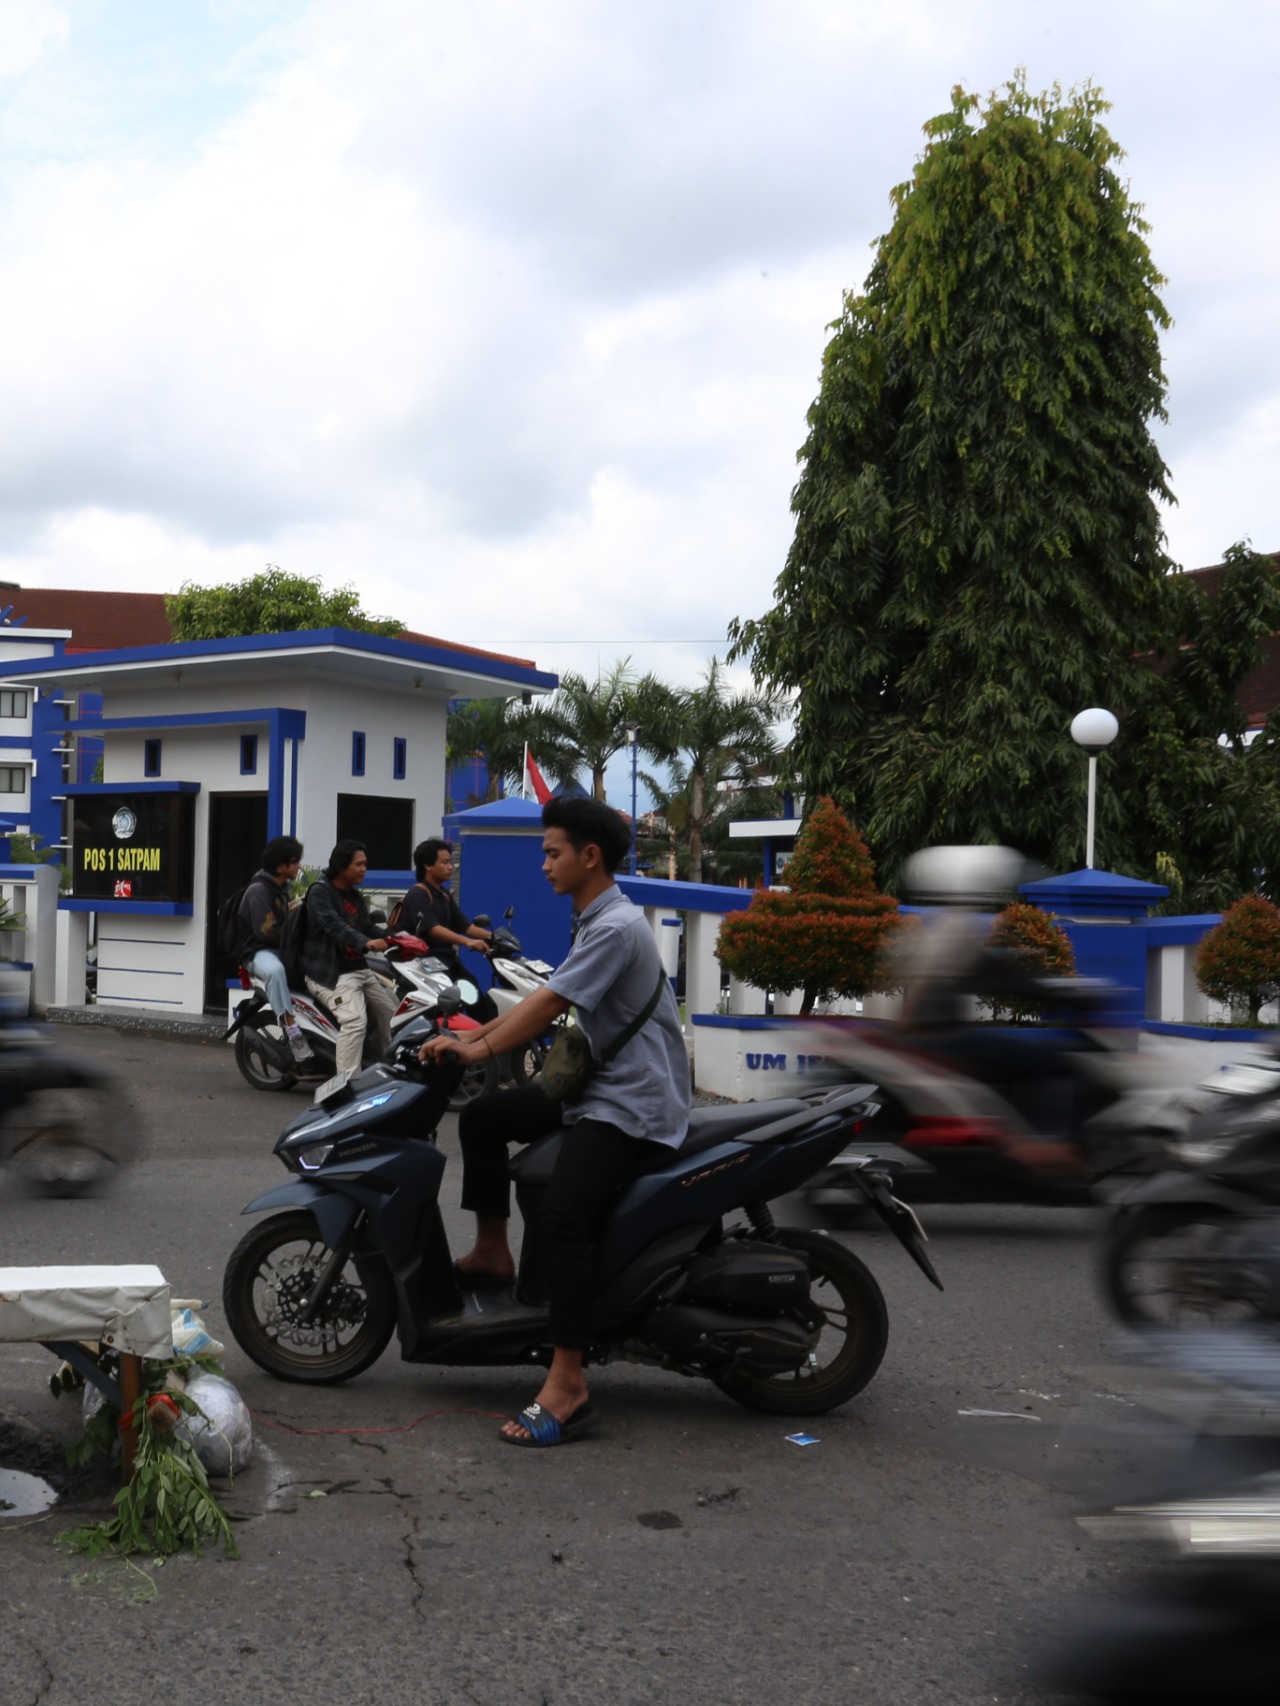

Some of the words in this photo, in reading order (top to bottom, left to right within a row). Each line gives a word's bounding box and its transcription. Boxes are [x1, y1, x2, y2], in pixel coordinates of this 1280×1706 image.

[84, 848, 106, 871] POS
[108, 848, 114, 871] 1
[117, 848, 160, 871] SATPAM
[746, 1053, 786, 1070] UM
[338, 1142, 378, 1158] HONDA
